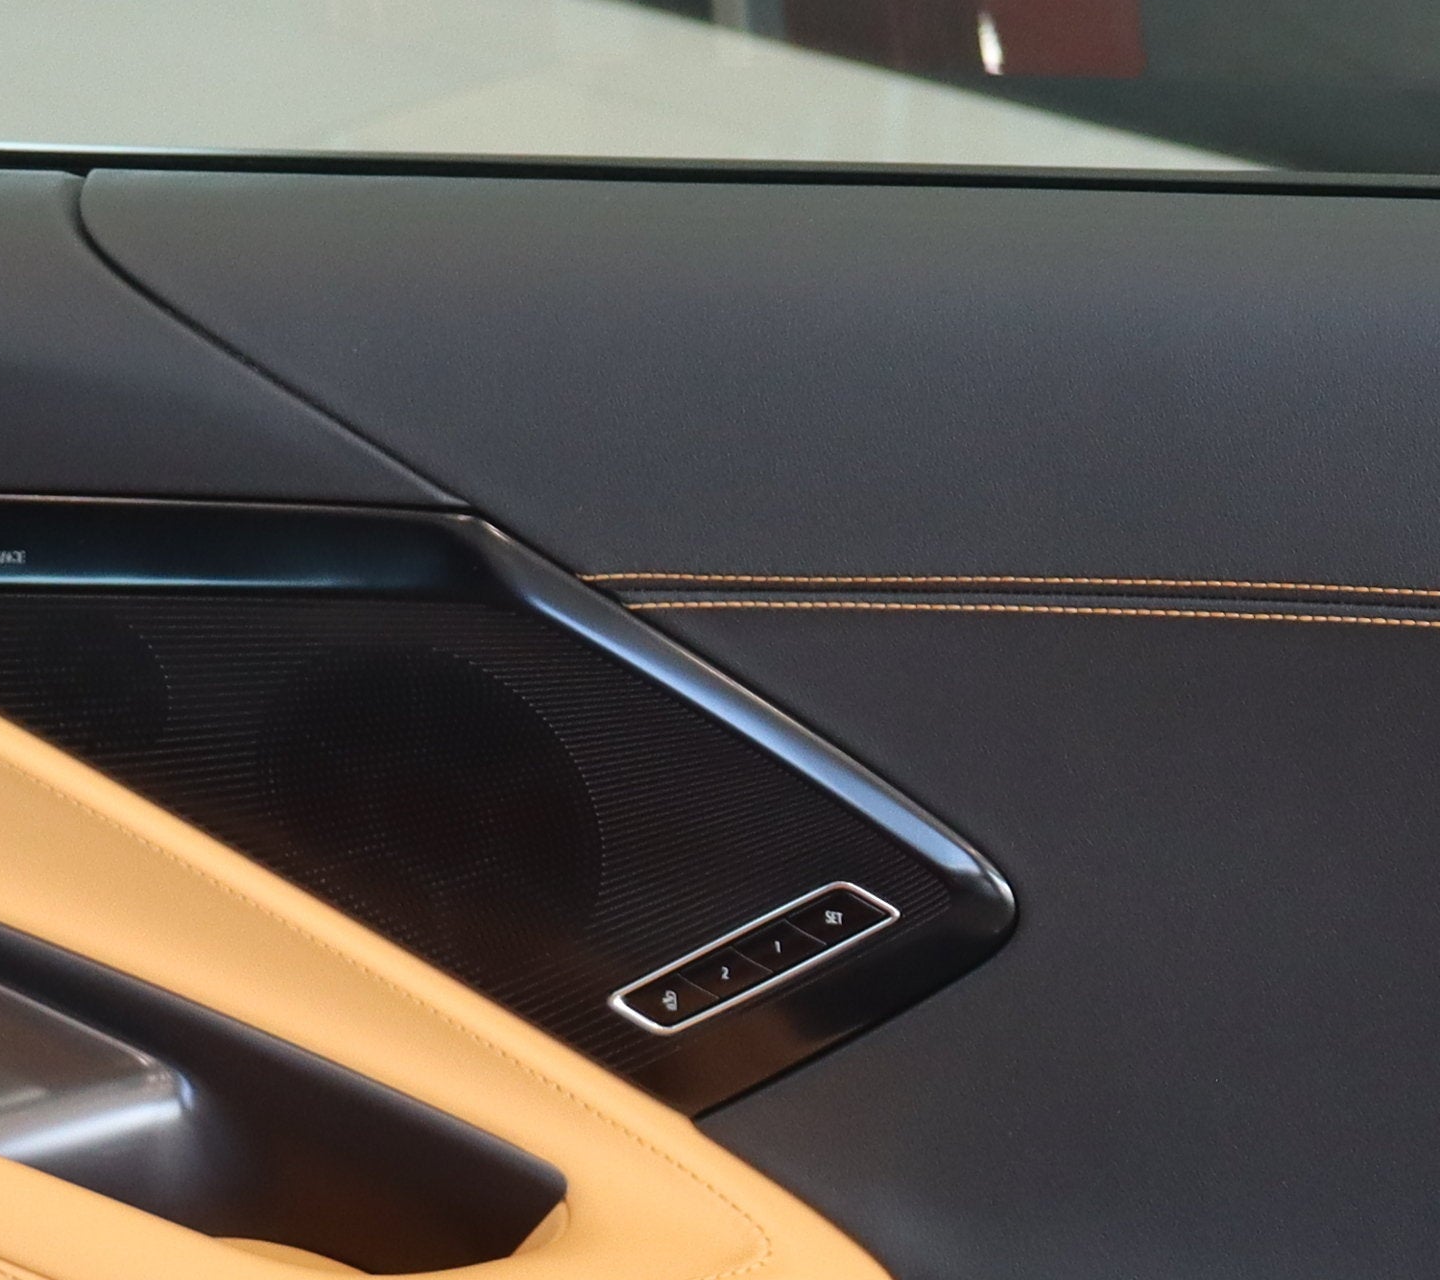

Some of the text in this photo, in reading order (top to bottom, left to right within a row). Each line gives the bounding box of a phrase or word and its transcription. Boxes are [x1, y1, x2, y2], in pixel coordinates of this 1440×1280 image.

[824, 910, 843, 926] SET
[774, 940, 782, 953] 1
[721, 966, 730, 981] 2
